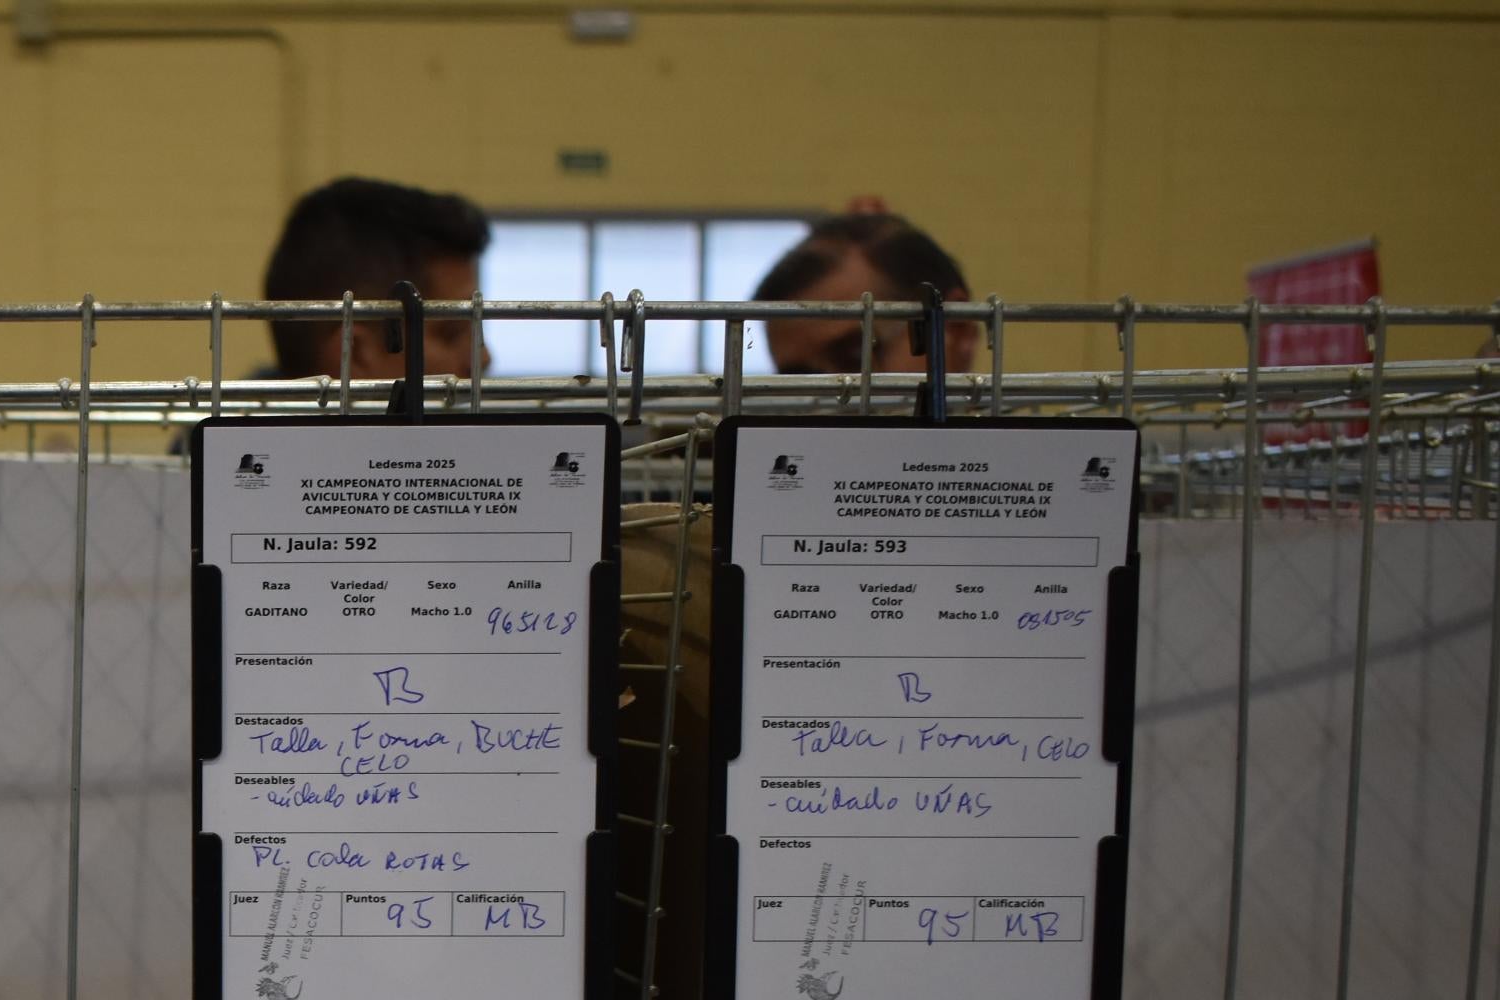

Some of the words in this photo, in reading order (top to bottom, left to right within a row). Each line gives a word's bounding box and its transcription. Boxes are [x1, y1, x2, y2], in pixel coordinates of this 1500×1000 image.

[369, 459, 422, 469] Ledesma
[426, 460, 456, 469] 2025
[903, 463, 956, 472] Ledesma
[960, 463, 989, 472] 2025
[300, 479, 313, 488] XI
[316, 479, 401, 488] CAMPEONATO
[405, 479, 503, 488] INTERNACIONAL
[506, 479, 523, 488] DE
[834, 481, 847, 490] XI
[849, 482, 934, 491] CAMPEONATO
[938, 482, 1034, 491] INTERNACIONAL
[1037, 482, 1053, 491] DE
[302, 493, 379, 502] AVICULTURA
[382, 493, 391, 501] Y
[393, 492, 506, 501] COLOMBICULTURA
[509, 492, 521, 501] IX
[834, 495, 911, 504] AVICULTURA
[914, 495, 923, 504] Y
[925, 495, 1037, 505] COLOMBICULTURA
[1039, 496, 1051, 505] IX
[305, 506, 390, 515] CAMPEONATO
[393, 506, 411, 515] DE
[413, 505, 471, 515] CASTILLA
[474, 505, 482, 514] Y
[485, 503, 517, 514] LEÓN
[837, 508, 921, 517] CAMPEONATO
[924, 509, 941, 517] DE
[944, 509, 1001, 518] CASTILLA
[1004, 509, 1012, 518] Y
[1015, 507, 1047, 518] LEÓN
[263, 538, 281, 551] N.
[286, 538, 339, 553] Jaula:
[344, 538, 377, 550] 592
[794, 541, 812, 553] N.
[816, 540, 868, 555] Jaula:
[874, 540, 907, 553] 593
[262, 582, 291, 591] Raza
[331, 581, 388, 591] Variedad/
[427, 581, 456, 590] Sexo
[508, 580, 542, 590] Anilla
[792, 584, 820, 593] Raza
[860, 583, 917, 594] Variedad/
[955, 585, 984, 594] Sexo
[1034, 584, 1068, 594] Anilla
[344, 594, 375, 603] Color
[872, 597, 903, 606] Color
[245, 608, 308, 617] GADITANO
[342, 607, 376, 617] OTRO
[411, 607, 450, 617] Macho
[453, 607, 472, 616] 1.0
[774, 610, 836, 619] GADITANO
[870, 610, 904, 620] OTRO
[939, 611, 977, 620] Macho
[980, 611, 999, 620] 1.0
[235, 656, 313, 666] Presentación
[763, 659, 840, 669] Presentación
[373, 667, 424, 705] B
[898, 672, 931, 702] B
[235, 717, 303, 726] Destacados
[762, 720, 830, 729] Destacados
[340, 755, 409, 777] CELO
[235, 776, 295, 785] Deseables
[761, 780, 821, 789] Deseables
[915, 784, 992, 818] UÑAS
[235, 835, 286, 845] Defectos
[760, 840, 811, 849] Defectos
[233, 894, 259, 904] Juez
[346, 894, 386, 903] Puntos
[456, 894, 524, 903] Calificación
[869, 899, 909, 908] Puntos
[979, 899, 1045, 908] Calificación
[757, 899, 782, 909] Juez
[387, 897, 434, 929] 95
[918, 908, 970, 945] 95
